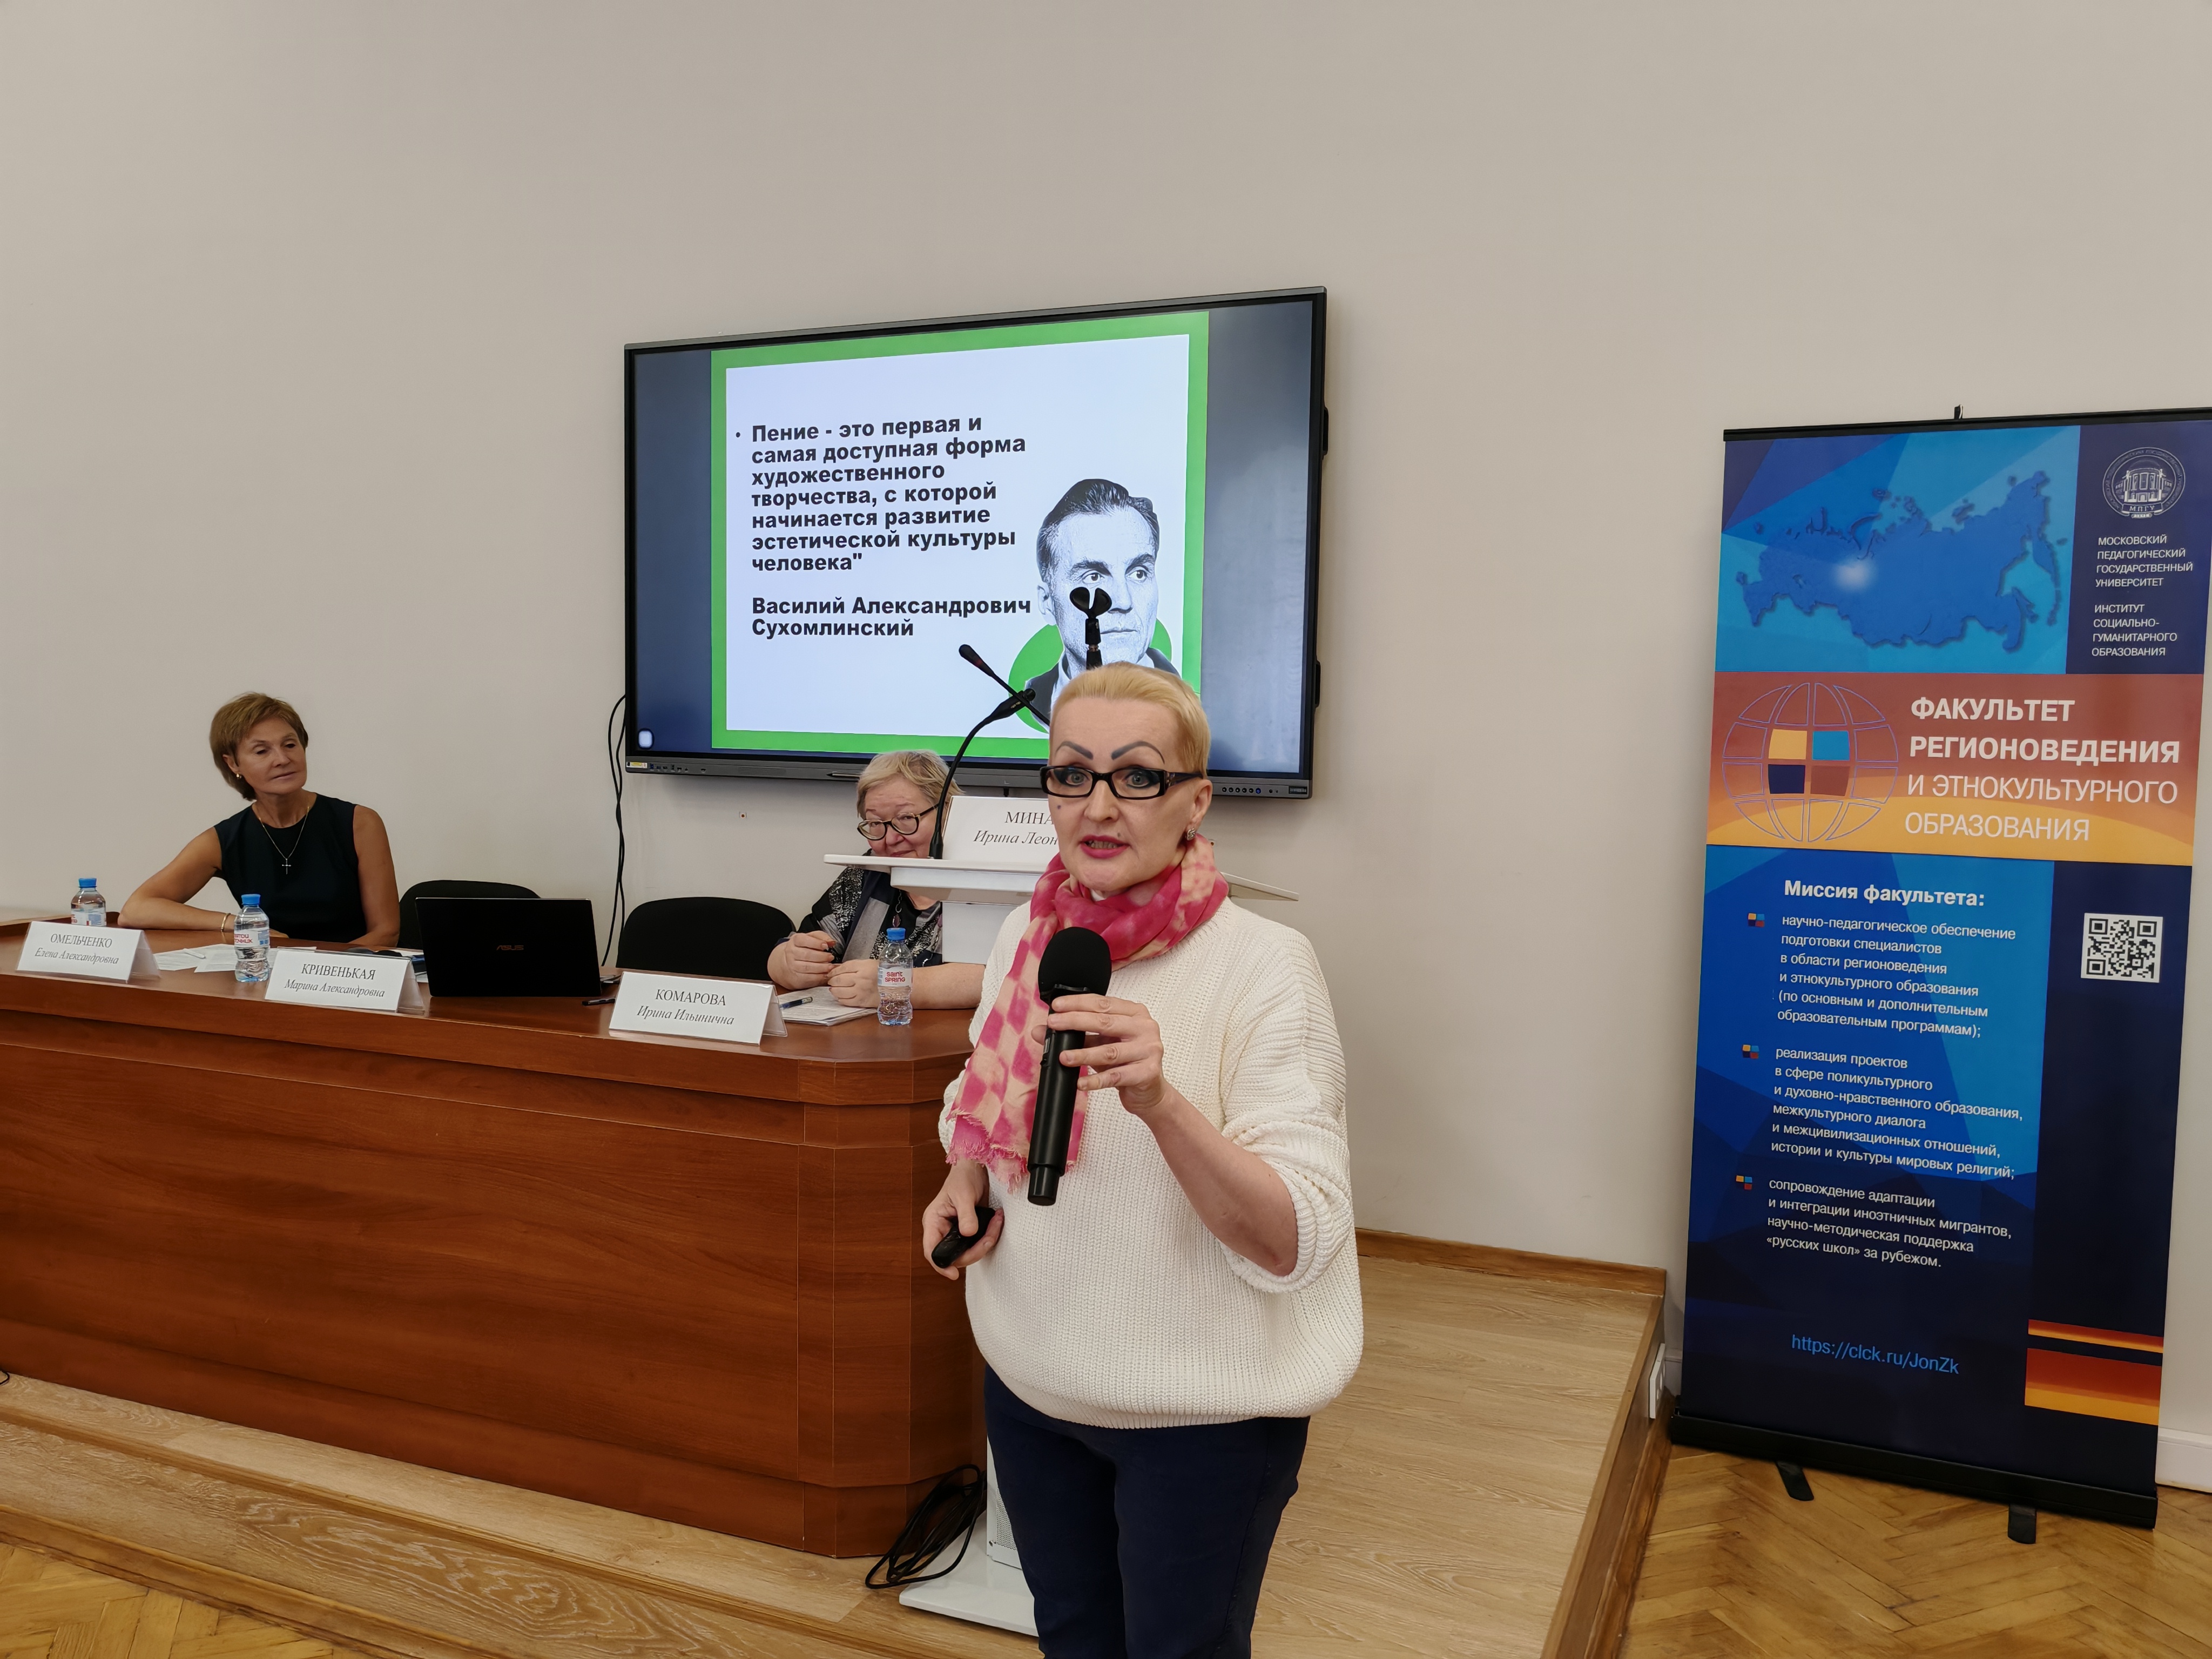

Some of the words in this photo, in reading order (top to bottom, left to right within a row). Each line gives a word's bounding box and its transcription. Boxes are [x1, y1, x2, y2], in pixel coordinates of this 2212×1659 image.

[753, 425, 819, 442] Пение
[839, 424, 874, 437] это
[882, 419, 960, 439] первая
[969, 417, 981, 430] и
[752, 449, 816, 463] самая
[824, 443, 937, 463] доступная
[946, 437, 1025, 459] форма
[752, 466, 944, 489] художественного
[752, 490, 876, 510] творчества,
[885, 490, 896, 502] с
[905, 481, 996, 504] которой
[753, 513, 876, 528] начинается
[886, 510, 990, 529] развитие
[752, 530, 899, 550] эстетической
[908, 532, 1015, 551] культуры
[2099, 534, 2167, 545] МОСКОВСКИЙ
[752, 553, 862, 571] человека"
[2098, 548, 2186, 561] ПЕДАГОГИЧЕСКИЙ
[2097, 562, 2193, 574] ГОСУДАРСТВЕННЫЙ
[2096, 578, 2163, 587] УНИВЕРСИТЕТ
[753, 597, 844, 613] Василий
[852, 597, 1030, 618] Александрович
[2095, 604, 2144, 613] ИНСТИТУТ
[752, 618, 913, 639] Сухомлинский
[2094, 618, 2159, 629] СОЦИАЛЬНО-
[2093, 633, 2177, 642] ГУМАНИТАРНОГО
[2092, 648, 2166, 656] ОБРАЗОВАНИЯ
[1911, 697, 2075, 721] ФАКУЛЬТЕТ
[1910, 736, 2179, 766] РЕГИОНОВЕДЕНИЯ
[1908, 774, 1924, 795] И
[1932, 775, 2177, 804] ЭТНОКУЛЬТУРНОГО
[1905, 812, 2089, 841] ОБРАЗОВАНИЯ
[974, 831, 1019, 845] Ирина
[1785, 880, 1857, 899] Миссия
[1864, 885, 1984, 906] факультета:
[1783, 917, 1927, 933] научно-педагогическое
[1931, 923, 2015, 939] обеспечение
[51, 934, 112, 948] ОМЕЛЬЧЕНКО
[1782, 936, 1850, 948] подготовки
[1854, 940, 1941, 954] специалистов
[35, 948, 58, 957] Елена
[59, 950, 119, 965] Александровна
[1791, 953, 1839, 966] области
[1844, 959, 1946, 974] регионоведения
[301, 964, 376, 980] КРИВЕНЬКАЯ
[284, 979, 319, 992] Марина
[319, 983, 385, 997] Александровна
[1780, 974, 1786, 982] и
[1791, 974, 1892, 989] этнокультурного
[1897, 980, 1978, 996] образования
[656, 989, 725, 1006] КОМАРОВА
[1779, 990, 1797, 1003] (по
[1802, 994, 1863, 1006] основным
[1867, 999, 1874, 1007] и
[1878, 1000, 1988, 1016] дополнительным
[637, 1006, 672, 1019] Ирина
[674, 1009, 734, 1024] Ильинична
[1778, 1009, 1887, 1028] образовательным
[1892, 1021, 1980, 1038] программам);
[1776, 1049, 1846, 1063] реализация
[1851, 1056, 1907, 1068] проектов
[1775, 1068, 1782, 1076] в
[1785, 1067, 1823, 1081] сфере
[1827, 1073, 1932, 1090] поликультурного
[1775, 1087, 1781, 1095] и
[1785, 1088, 1931, 1109] духовно-нравственного
[1935, 1101, 2022, 1121] образования,
[1773, 1105, 1871, 1123] межкультурного
[1875, 1116, 1925, 1128] диалога
[1772, 1124, 1779, 1132] и
[1784, 1125, 1920, 1147] межцивилизационных
[1924, 1140, 2000, 1158] отношений,
[1772, 1143, 1820, 1156] истории
[1825, 1149, 1832, 1157] и
[1837, 1150, 1892, 1164] культуры
[1897, 1156, 1952, 1171] мировых
[1957, 1163, 2014, 1179] религий;
[1769, 1181, 1865, 1199] сопровождение
[1869, 1192, 1934, 1208] адаптации
[1769, 1199, 1776, 1207] и
[1780, 1201, 1849, 1216] интеграции
[1854, 1209, 1935, 1227] иноэтничных
[1939, 1220, 2011, 1239] мигрантов,
[1767, 1218, 1899, 1243] научно-методическая
[1904, 1235, 1973, 1252] поддержка
[1767, 1237, 1819, 1250] «русских
[1823, 1244, 1860, 1255] школ»
[1864, 1249, 1877, 1258] за
[1881, 1250, 1941, 1267] рубежом.
[1792, 1334, 1959, 1374] https://clck.ru/JonZk
